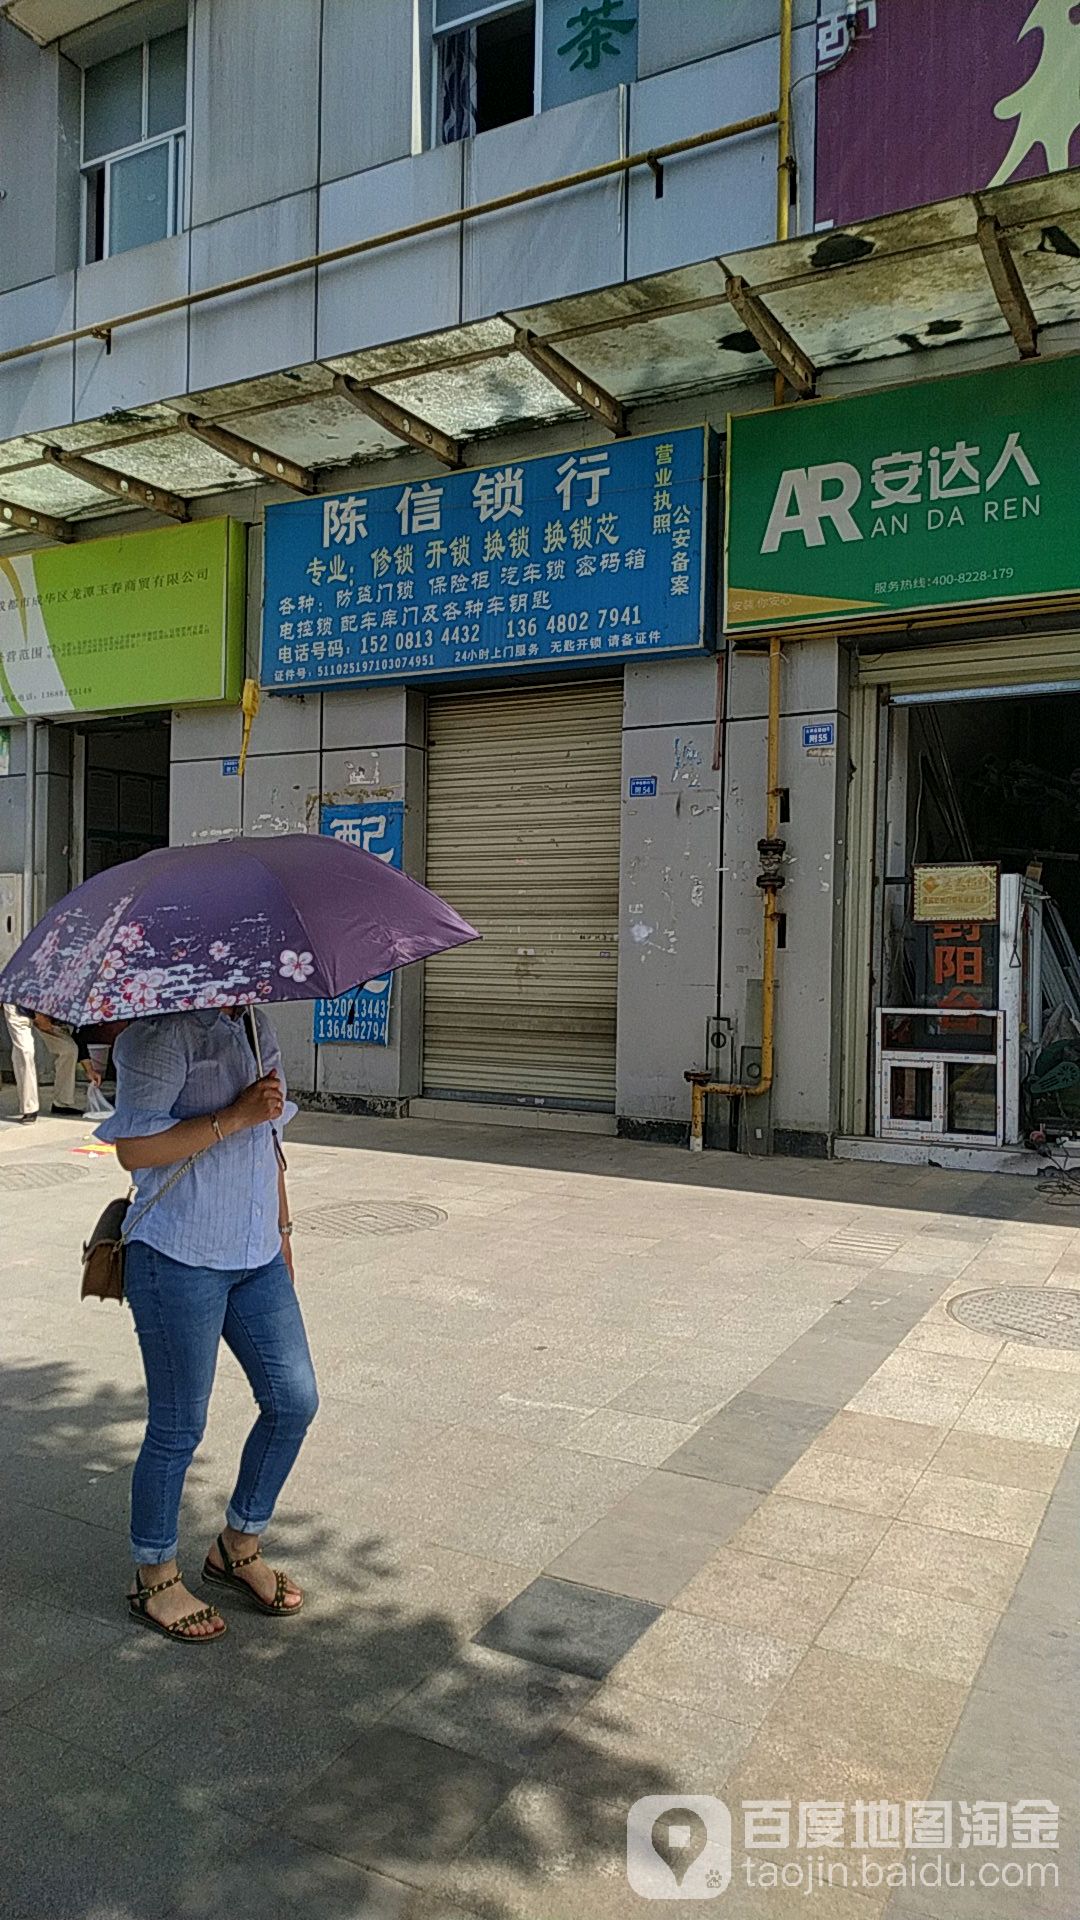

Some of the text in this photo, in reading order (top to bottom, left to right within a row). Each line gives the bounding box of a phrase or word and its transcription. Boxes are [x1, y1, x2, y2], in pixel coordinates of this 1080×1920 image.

[557, 0, 637, 72] 茶
[322, 452, 611, 549] 陈信锁行
[652, 443, 674, 535] 营业执照
[870, 432, 1041, 510] 安达人
[760, 461, 864, 555] AR
[870, 494, 1041, 538] AN DA REN
[336, 580, 415, 609] 防盗门锁
[428, 569, 491, 597] 保险柜
[500, 558, 567, 586] 汽车锁
[575, 547, 647, 578] 密码箱
[370, 543, 415, 580] 修锁
[424, 534, 472, 570] 开锁
[482, 525, 531, 563] 换锁
[542, 512, 620, 555] 换锁芯
[670, 504, 692, 597] 公安备案
[278, 590, 552, 641] 电控锁 配车库门及各种车钥匙
[360, 634, 388, 655] 152
[395, 629, 433, 650] 0813
[440, 623, 480, 646] 4432
[506, 617, 537, 639] 136
[545, 611, 590, 634] 4802
[597, 605, 642, 629] 7941
[454, 642, 540, 663] 24小时上门服务
[550, 635, 602, 654] 无匙开锁
[607, 629, 661, 648] 请备证件
